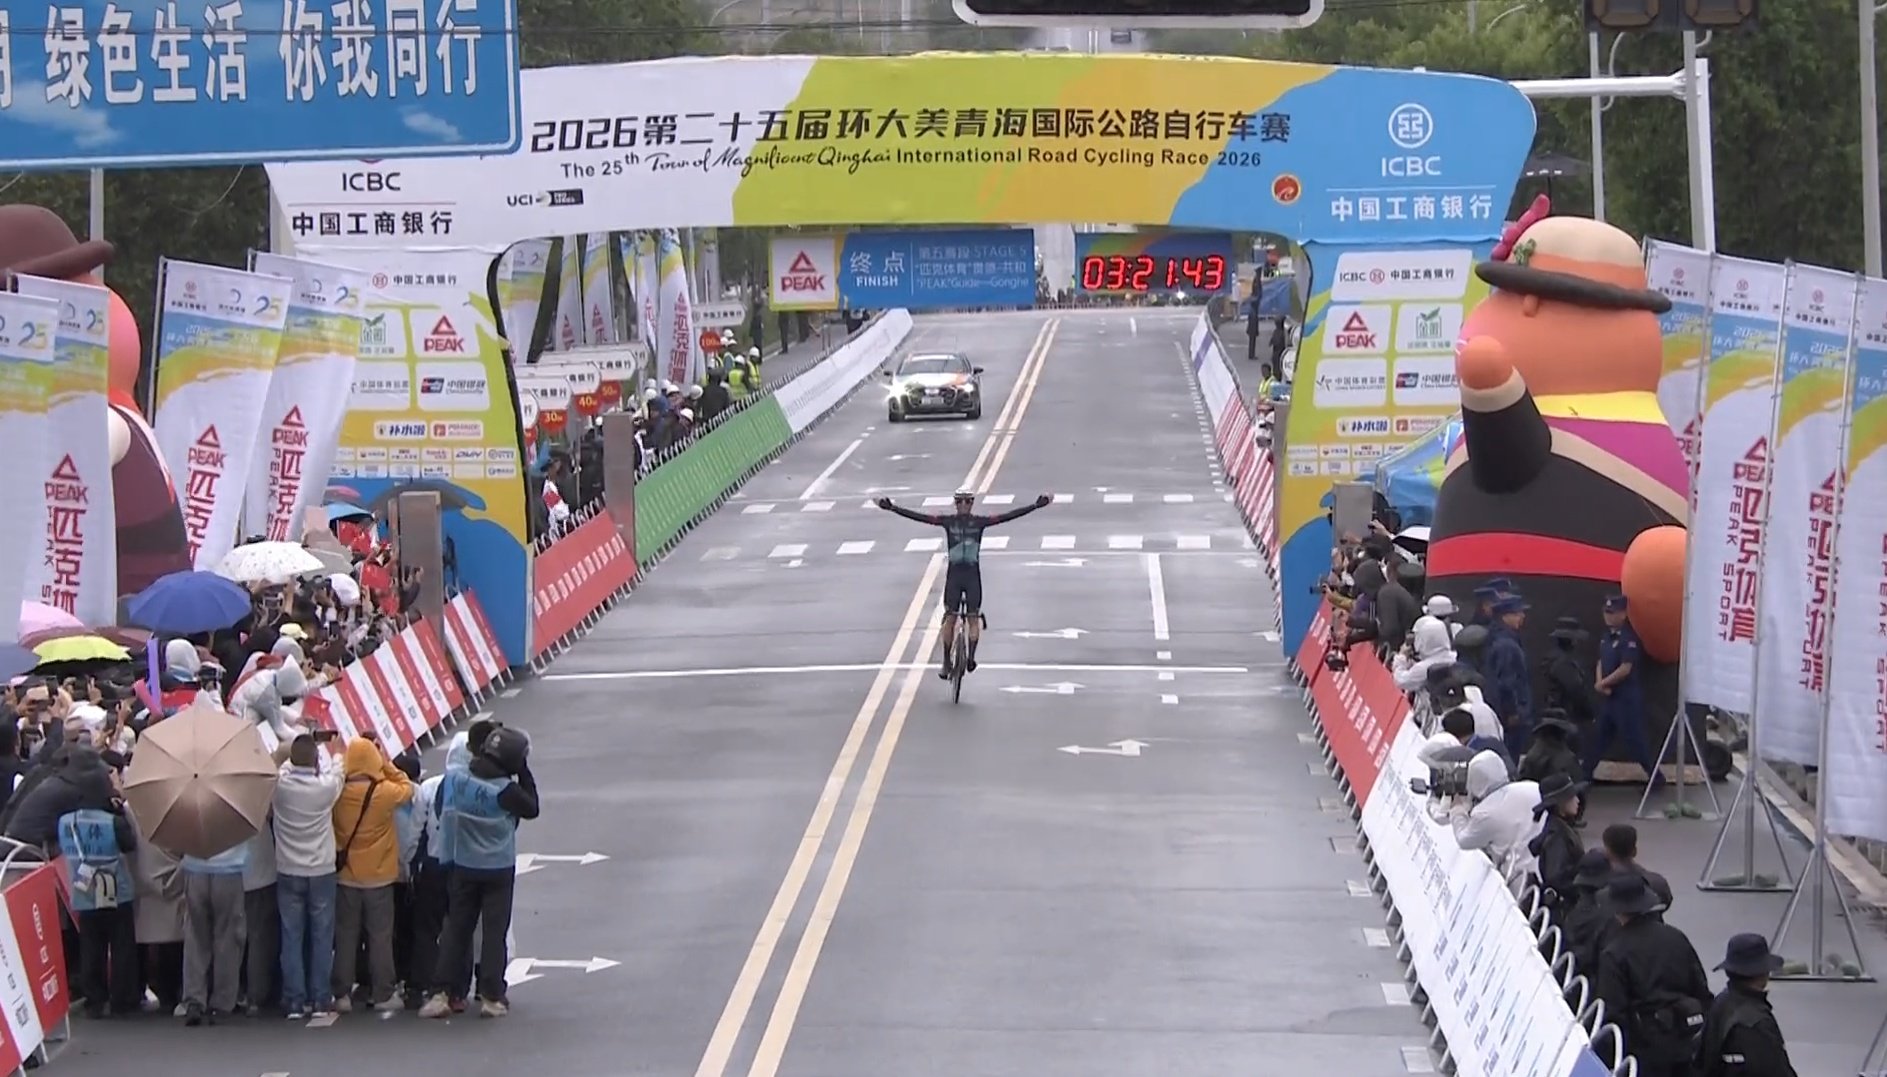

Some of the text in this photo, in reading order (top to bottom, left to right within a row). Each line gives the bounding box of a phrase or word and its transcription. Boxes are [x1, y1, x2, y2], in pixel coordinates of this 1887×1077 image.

[44, 2, 248, 108] 绿色生活
[279, 0, 482, 101] 你我同行
[531, 107, 1291, 153] 2026第二十五届环大美青海国际公路自行车赛
[561, 163, 595, 178] The
[602, 151, 640, 176] 25th
[817, 145, 891, 175] Qinghai
[897, 147, 1021, 164] International
[1028, 147, 1078, 163] Road
[1084, 148, 1154, 167] Cycling
[1161, 148, 1209, 165] Race
[1217, 151, 1262, 167] 2026
[1381, 156, 1442, 177] ICBC
[342, 172, 401, 192] ICBC
[507, 194, 533, 207] UCI
[1330, 194, 1493, 222] 中国工商银行
[292, 211, 453, 236] 中国工商银行
[850, 251, 905, 274] 终点
[393, 274, 457, 285] 中国工商银行
[780, 274, 826, 292] PEAK
[856, 276, 899, 288] FINISH
[1339, 271, 1367, 283] ICBC
[1391, 268, 1455, 281] 中国工商银行
[423, 337, 465, 352] PEAK
[1335, 333, 1378, 349] PEAK
[272, 428, 309, 448] PEAK
[187, 447, 228, 469] PEAK
[44, 482, 89, 504] PEAK
[1725, 484, 1743, 546] PEAK
[1718, 562, 1735, 641] SPORT
